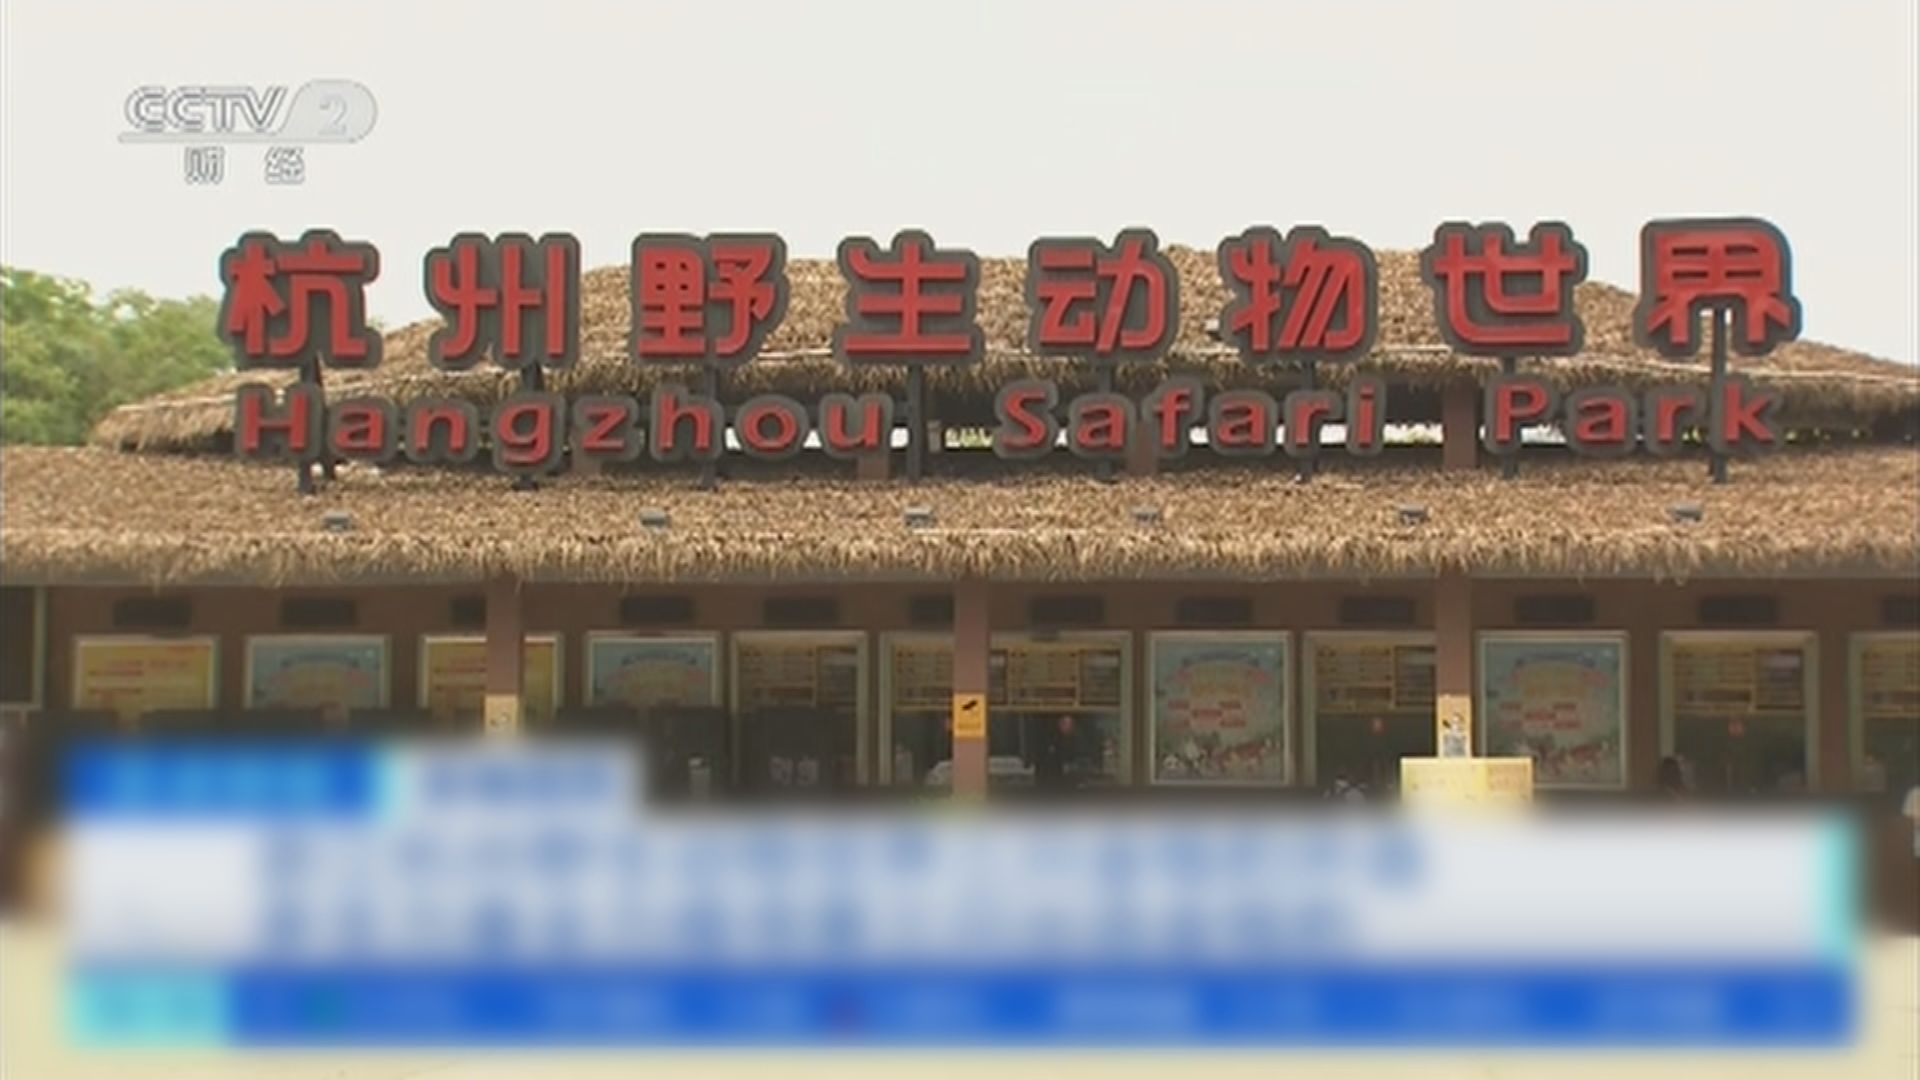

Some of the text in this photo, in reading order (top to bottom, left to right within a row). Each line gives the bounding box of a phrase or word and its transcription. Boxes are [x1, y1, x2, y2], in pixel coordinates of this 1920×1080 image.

[225, 228, 1793, 360] 杭州野生动物世界
[242, 383, 1778, 463] Hangzhou Safari Park
